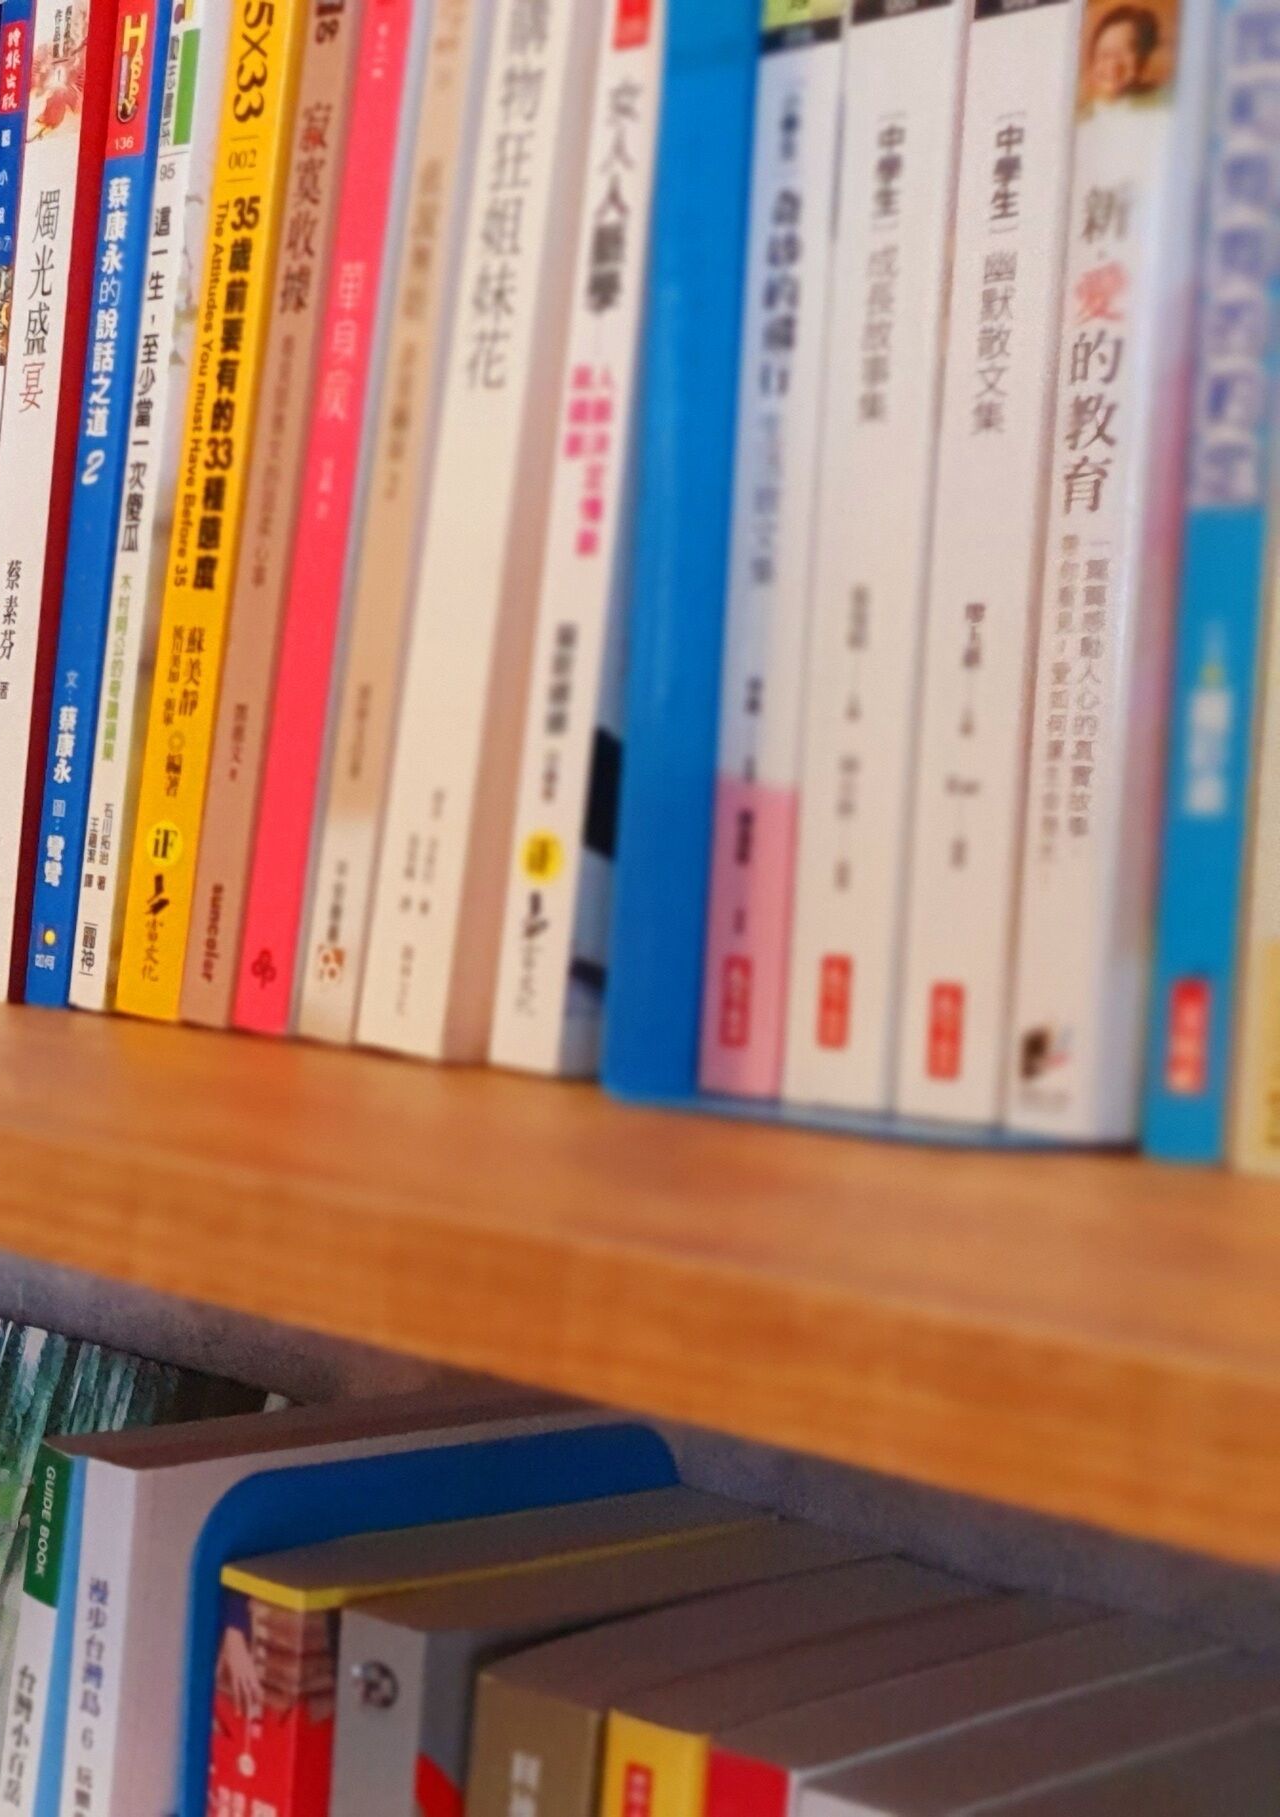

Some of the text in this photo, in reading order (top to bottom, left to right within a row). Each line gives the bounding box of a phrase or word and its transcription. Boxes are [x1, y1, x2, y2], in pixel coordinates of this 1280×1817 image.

[1, 27, 22, 110] 時報出版
[113, 136, 135, 151] 136
[159, 163, 176, 181] 95
[228, 149, 257, 169] 002
[18, 188, 61, 413] 燭光盛宴
[80, 176, 131, 486] 蔡康永的說話之道 2
[120, 205, 172, 553] 這一生，至少當一次傻瓜
[173, 201, 230, 588] The Attitudes You must Have Before 35
[53, 705, 79, 784] 蔡康永
[201, 883, 224, 983] suncolor
[34, 1465, 57, 1578] GUIDE BOOK
